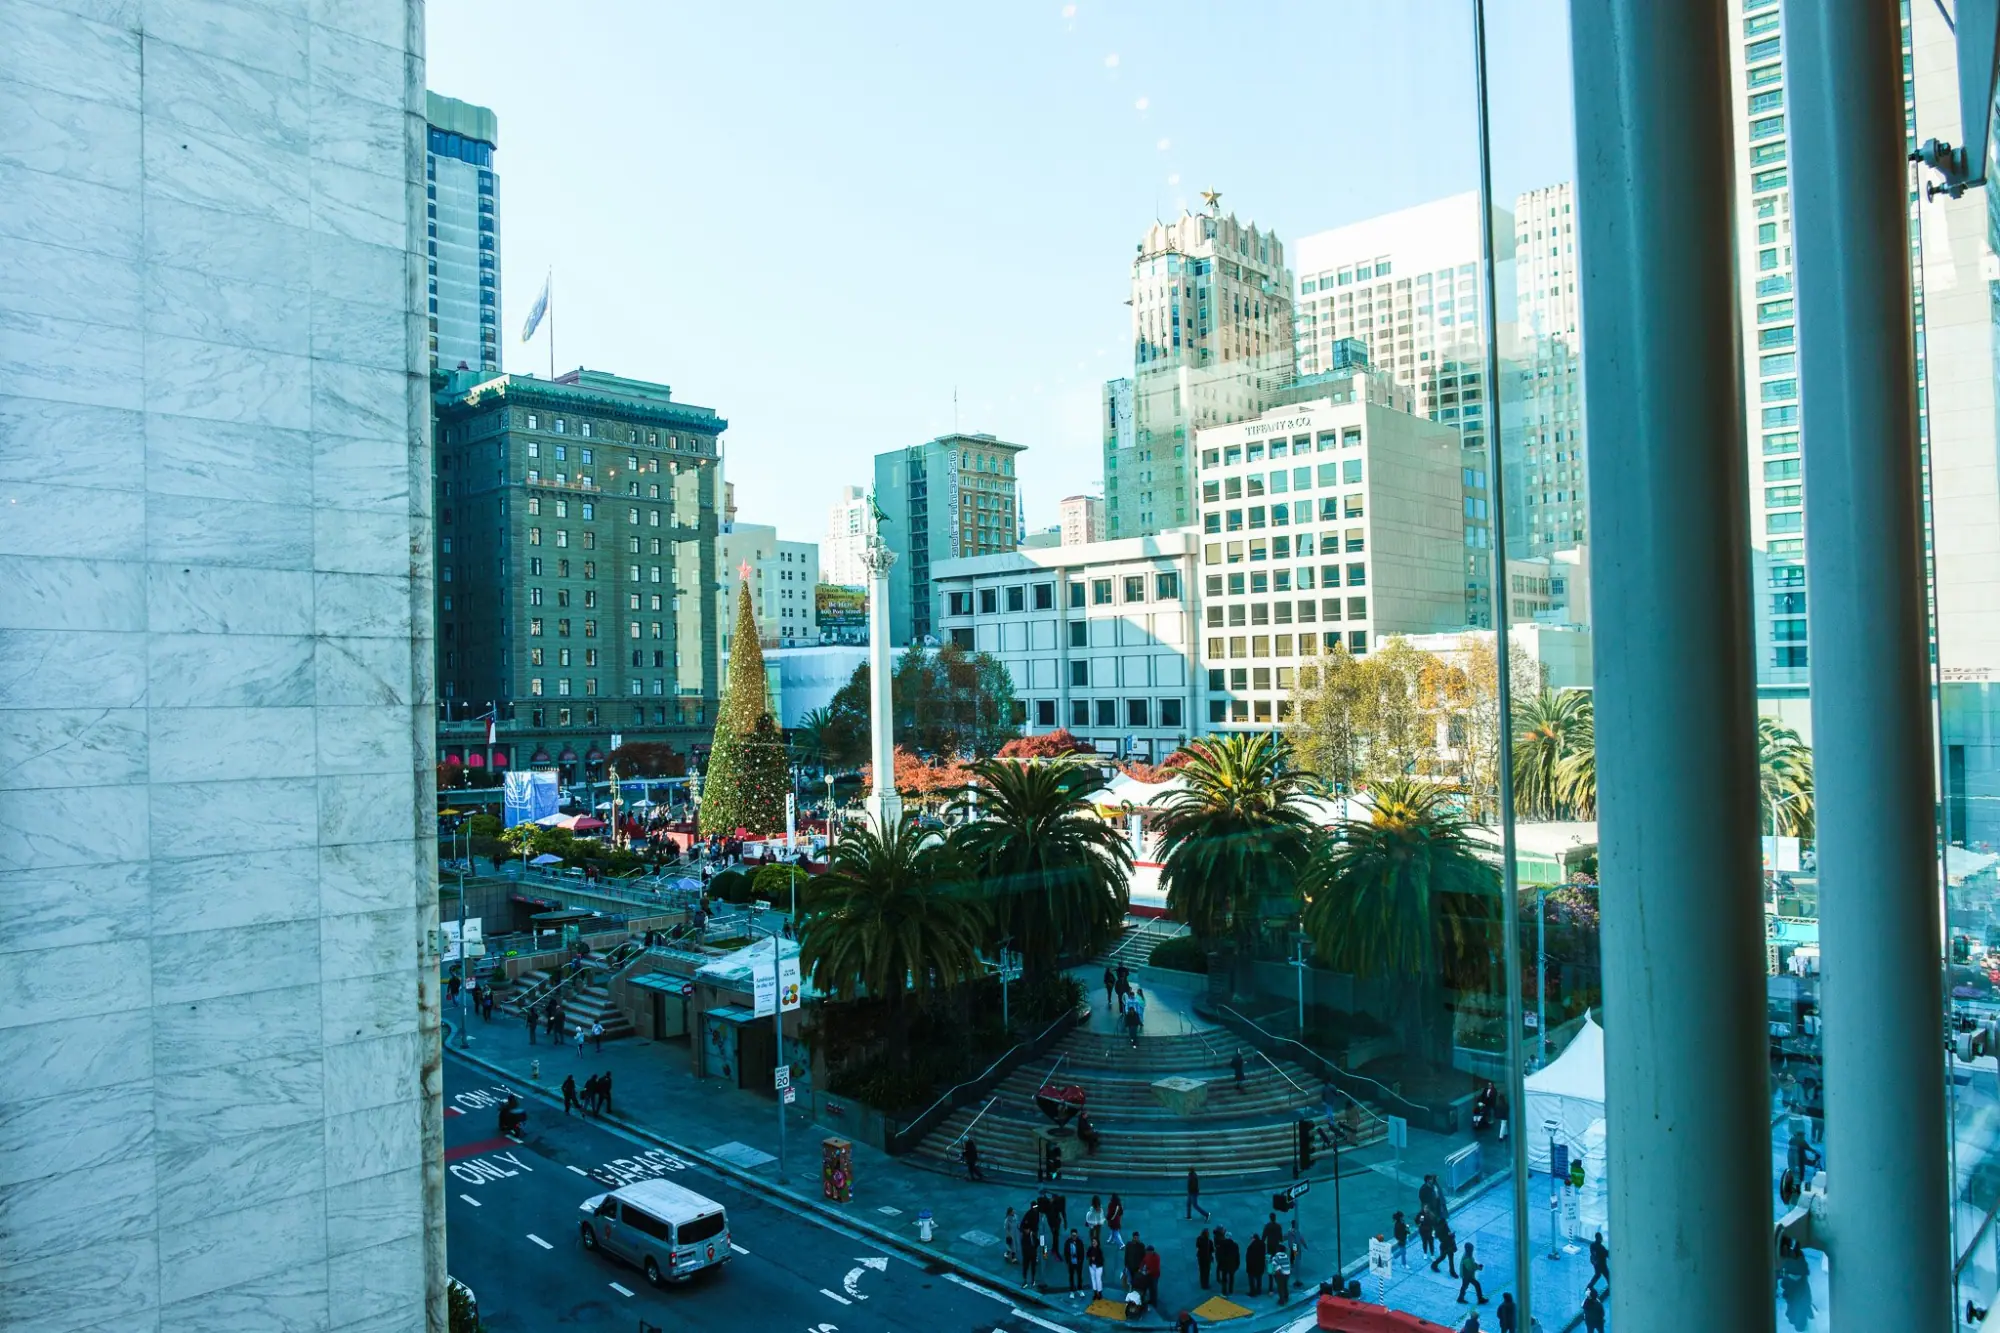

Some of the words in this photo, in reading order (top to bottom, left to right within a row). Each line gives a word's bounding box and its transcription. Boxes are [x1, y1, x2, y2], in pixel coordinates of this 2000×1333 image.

[1245, 420, 1287, 436] TIFFANY
[1288, 420, 1295, 429] &
[777, 1076, 788, 1087] 20
[455, 1084, 524, 1110] ONLY
[449, 1151, 534, 1185] ONLY
